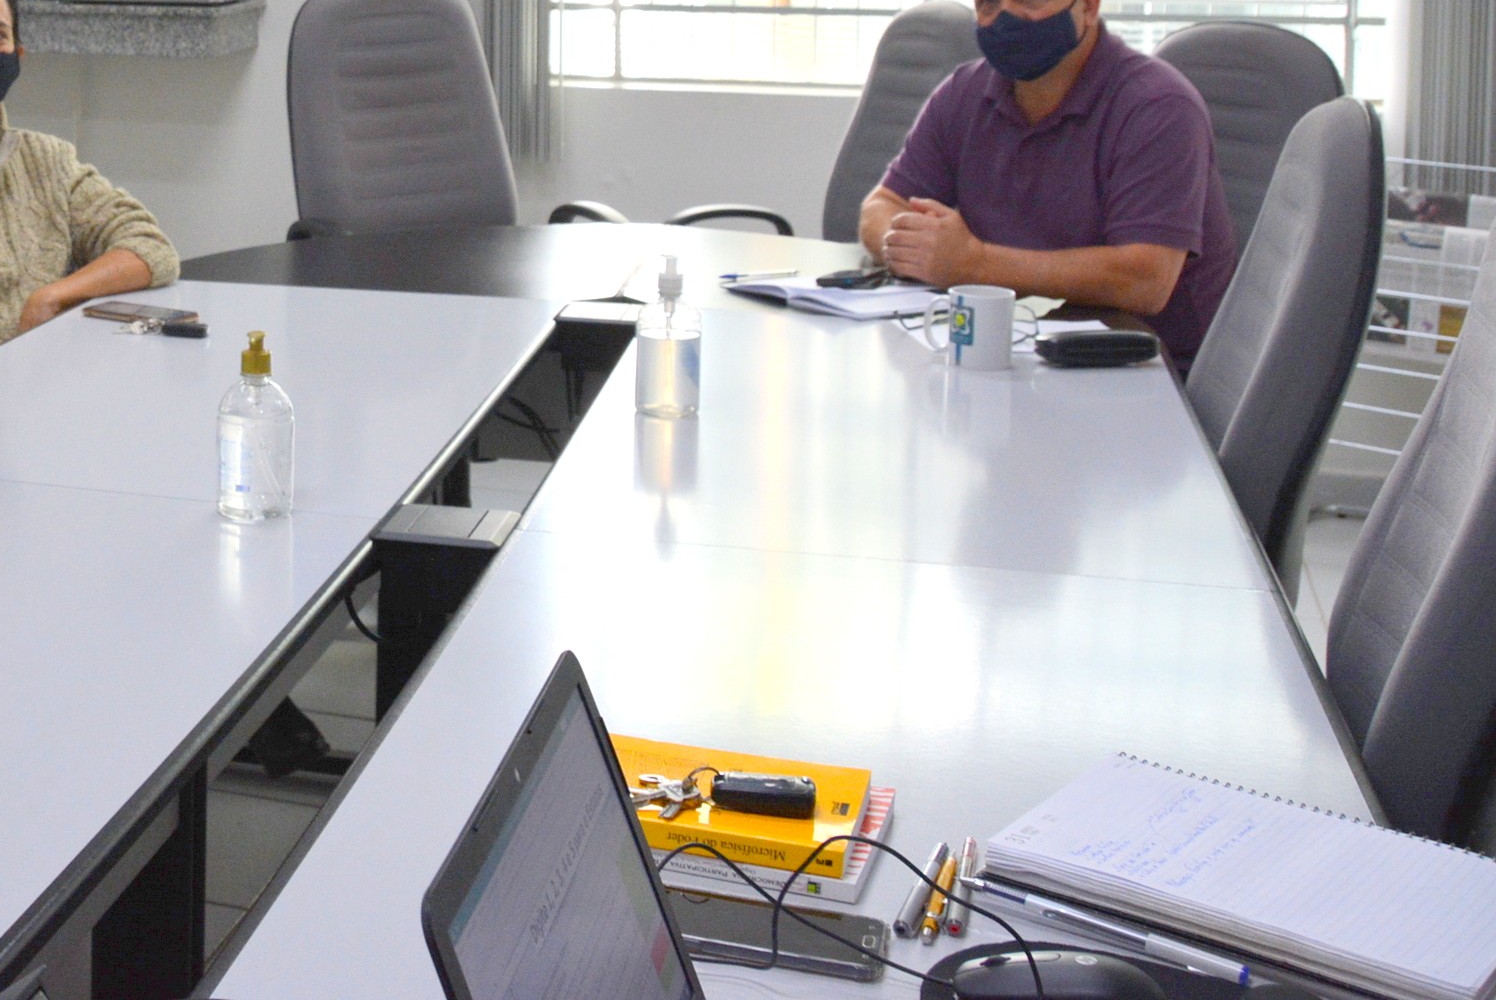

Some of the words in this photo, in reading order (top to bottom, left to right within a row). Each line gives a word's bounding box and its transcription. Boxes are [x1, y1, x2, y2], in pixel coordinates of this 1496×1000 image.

[703, 838, 717, 847] do
[721, 840, 786, 861] Microfísica
[670, 862, 728, 877] PARTICIPATIVA
[732, 873, 788, 887] DEMOCIA
